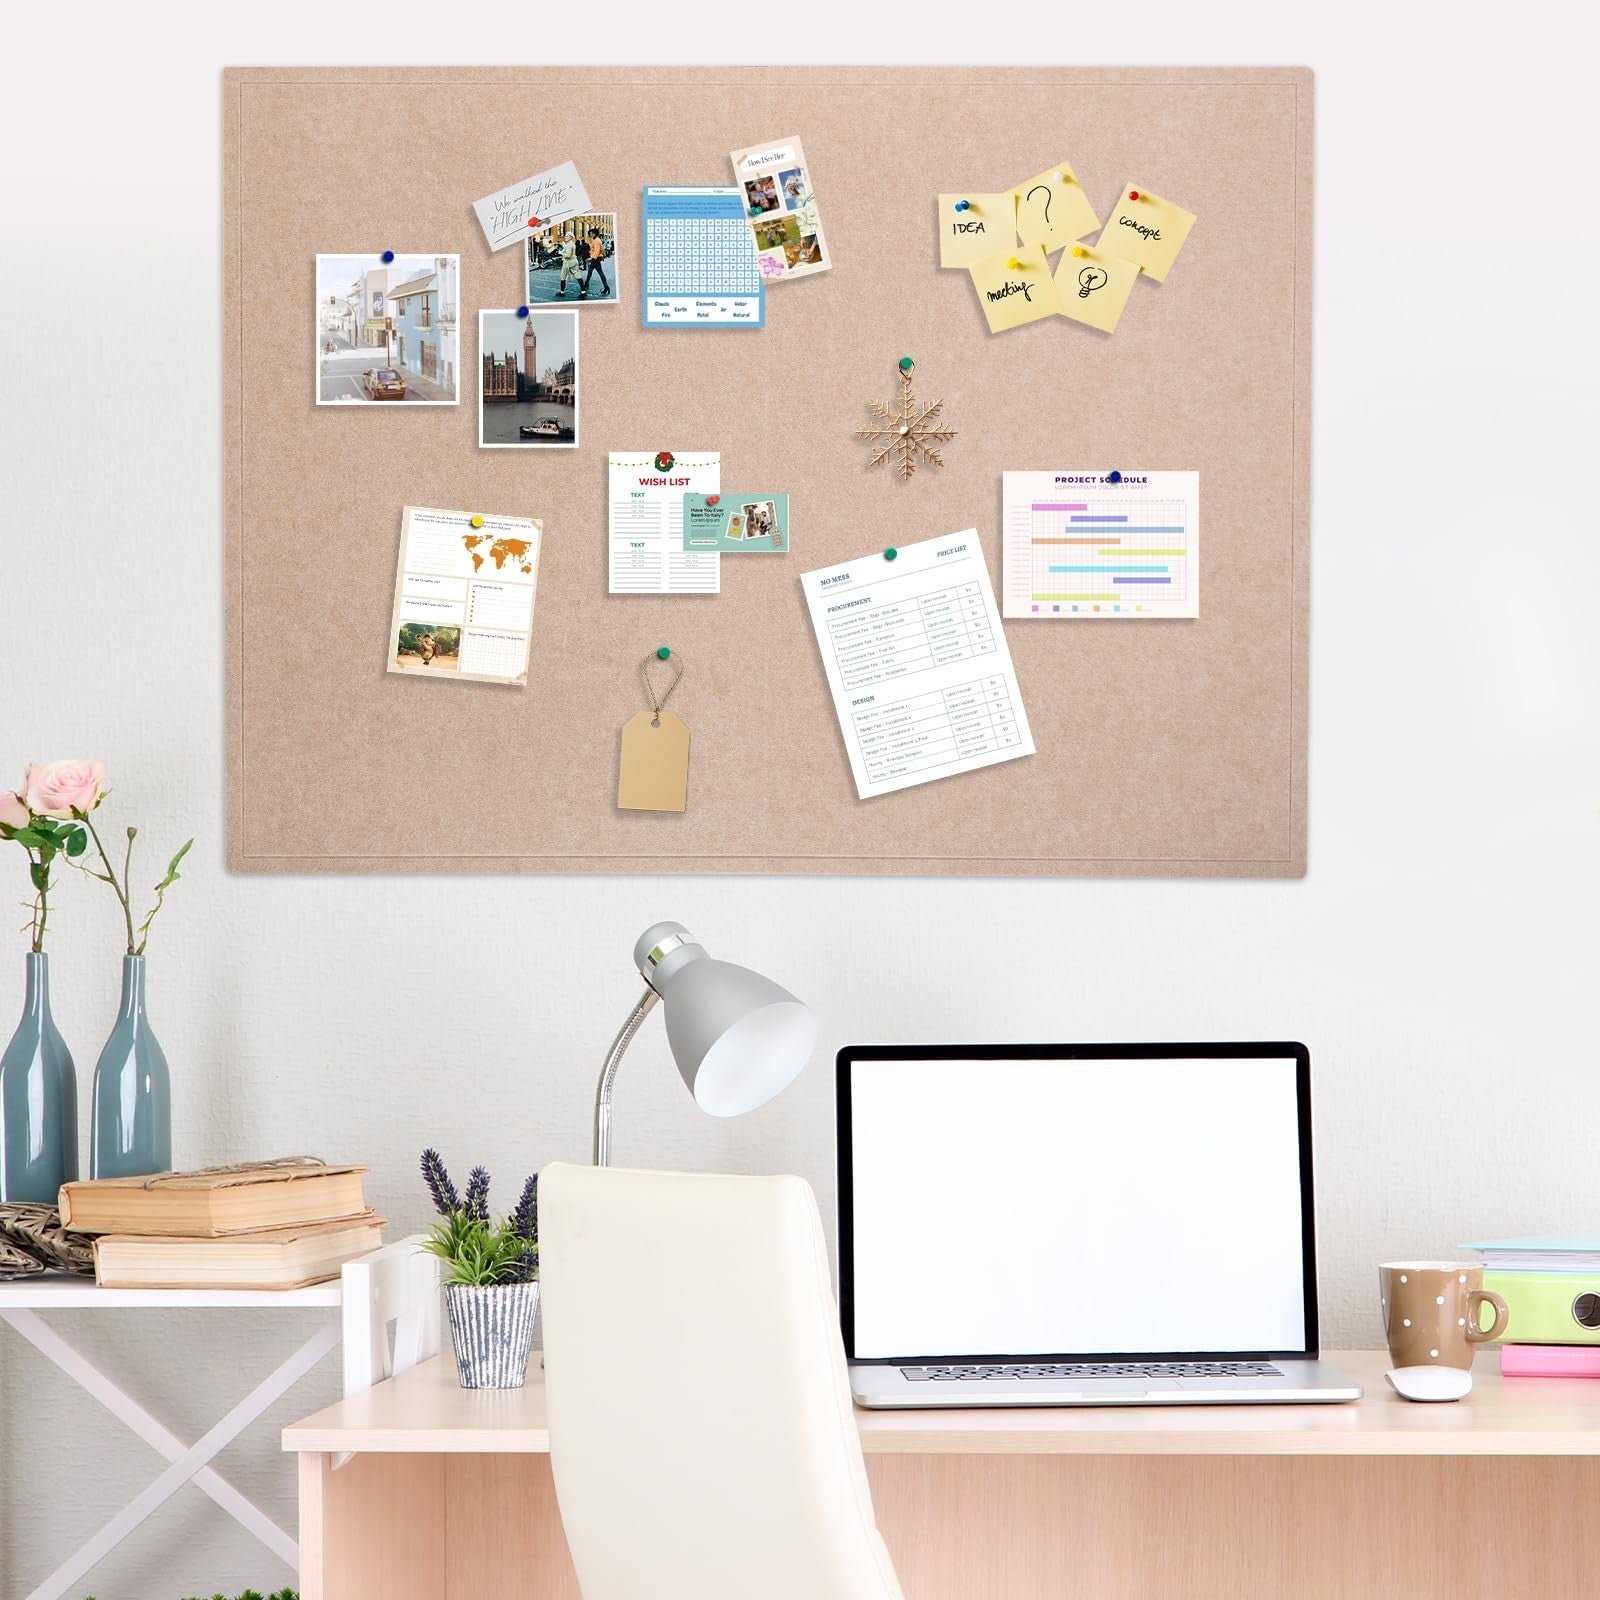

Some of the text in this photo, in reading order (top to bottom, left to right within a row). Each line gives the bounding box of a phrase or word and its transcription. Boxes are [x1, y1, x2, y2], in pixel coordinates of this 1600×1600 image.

[514, 182, 542, 203] walked
[1026, 186, 1054, 232] ?
[953, 222, 985, 235] IDEA
[1119, 216, 1162, 240] concept
[987, 280, 1035, 302] meeting
[639, 478, 691, 486] WISH LIST
[936, 549, 954, 558] PRICE
[831, 574, 851, 583] MESS
[827, 598, 872, 613] PROCUREMENT
[852, 696, 875, 706] DESIGN
